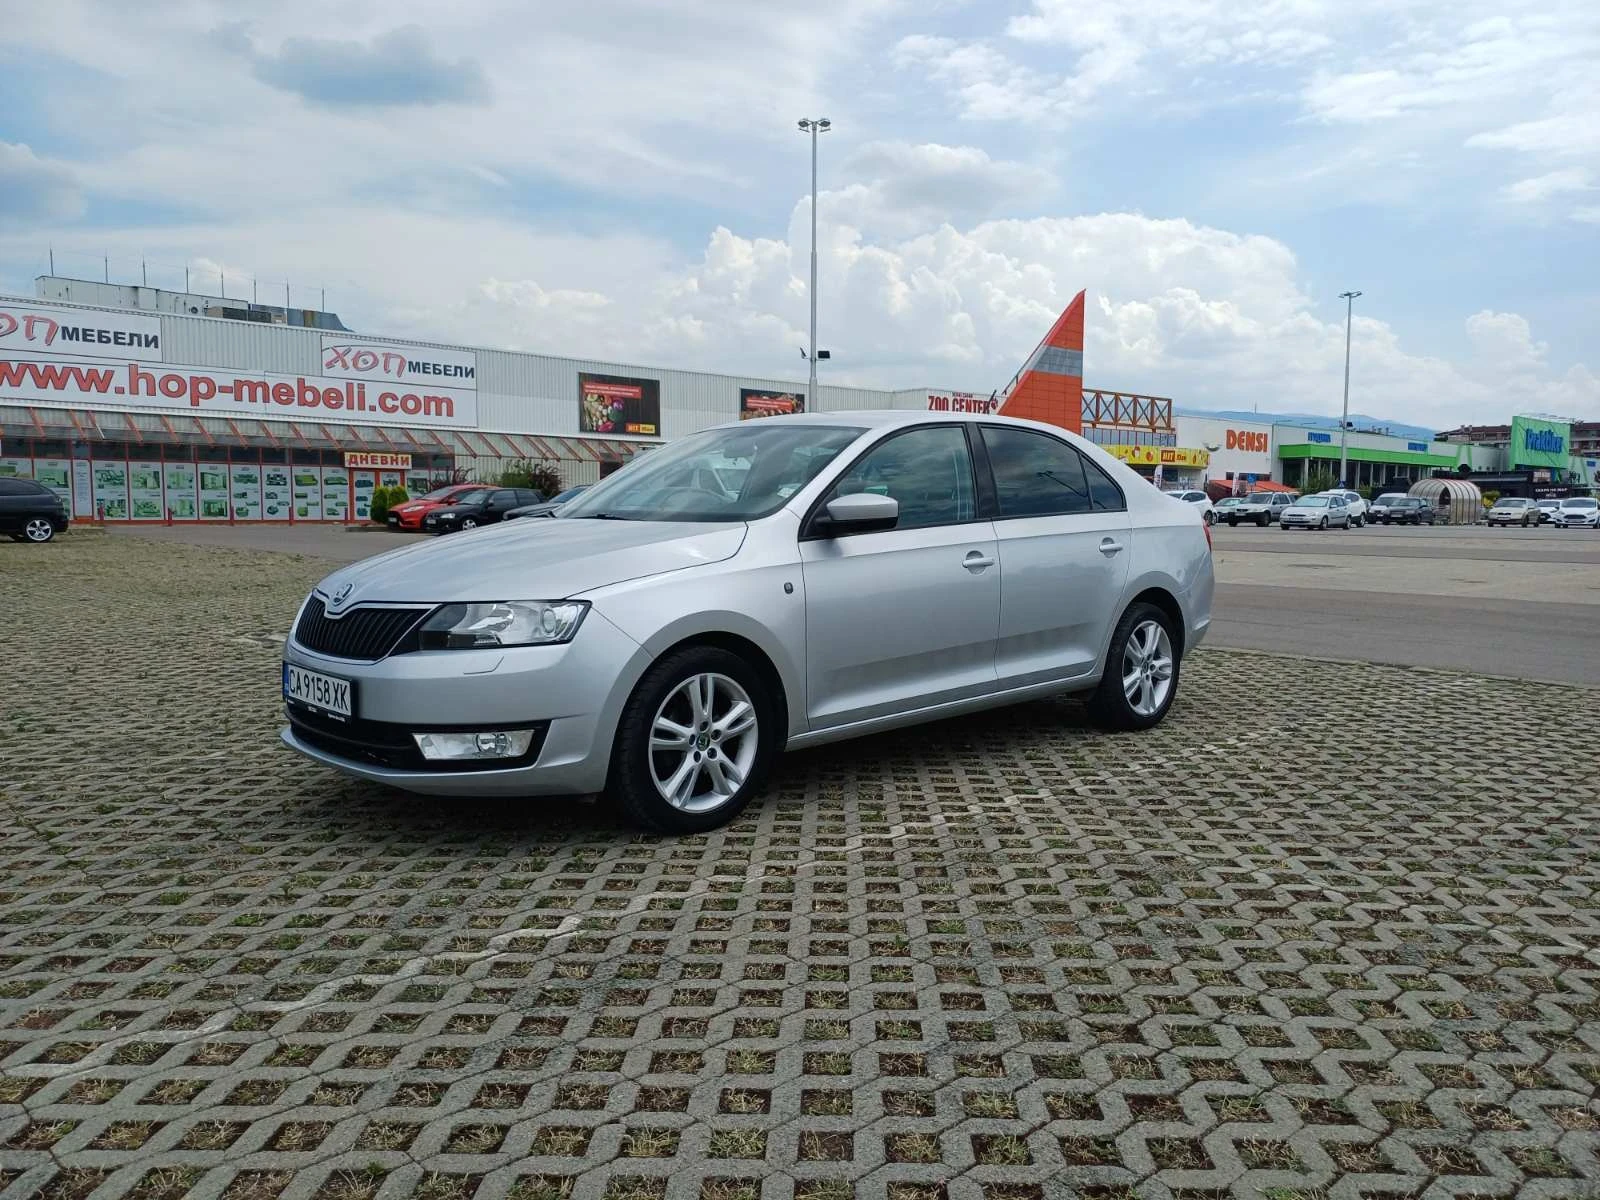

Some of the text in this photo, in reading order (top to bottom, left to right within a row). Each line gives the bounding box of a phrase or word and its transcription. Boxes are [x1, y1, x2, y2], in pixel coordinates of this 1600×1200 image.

[61, 326, 160, 349] МЕБЕЛИ
[407, 361, 475, 379] МЕБЕЛИ
[0, 361, 454, 417] www.hop-mebeli.com
[928, 395, 990, 414] ZOO CENTER
[1226, 429, 1268, 452] DENSI
[348, 453, 410, 466] ДНЕВНИ
